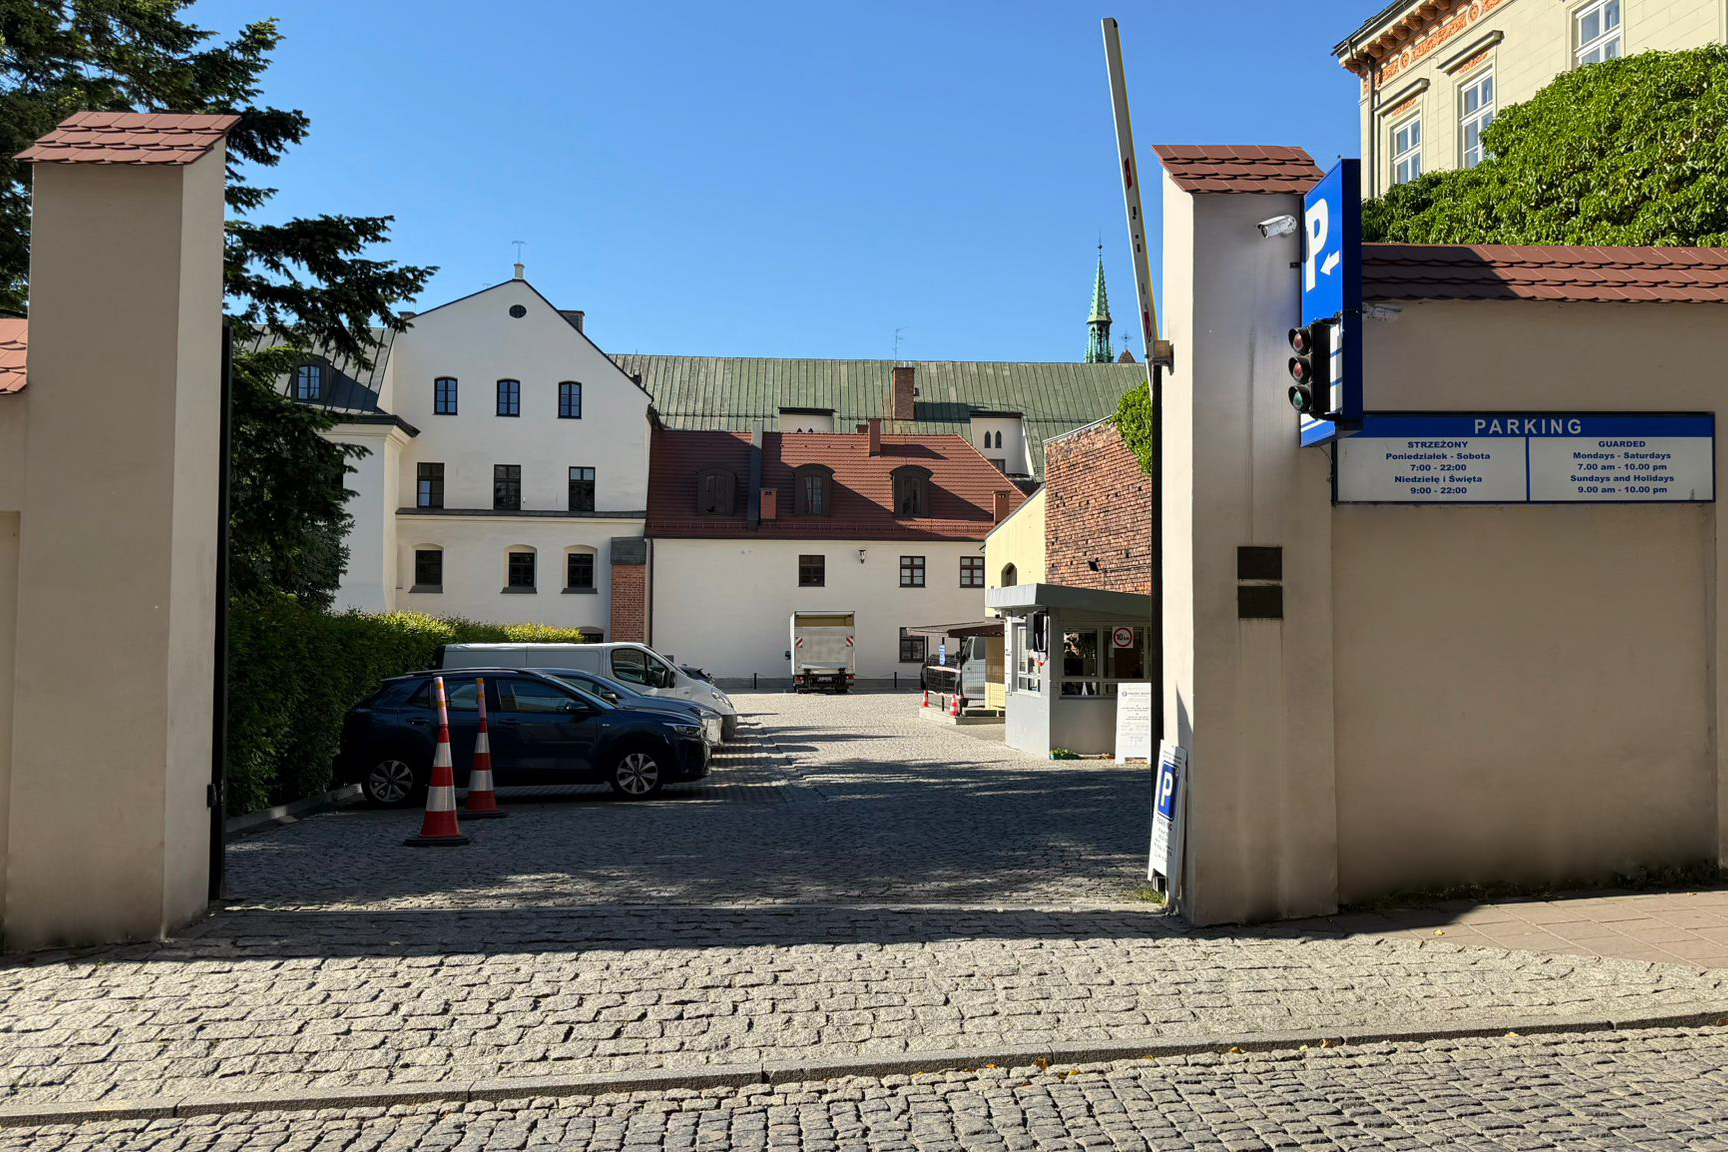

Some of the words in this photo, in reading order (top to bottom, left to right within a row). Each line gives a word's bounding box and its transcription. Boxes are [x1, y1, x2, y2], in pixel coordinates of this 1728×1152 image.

[1305, 198, 1328, 292] P
[1474, 418, 1581, 434] PARKING
[1408, 440, 1468, 448] STRZEŻONY
[1386, 452, 1448, 460] Poniedziałek
[1457, 452, 1490, 460] Sobota
[1573, 452, 1615, 460] Mondays
[1623, 452, 1672, 460] Saturdays
[1394, 476, 1439, 484] Niedzielę
[1449, 474, 1482, 484] Święta
[1160, 771, 1173, 807] P
